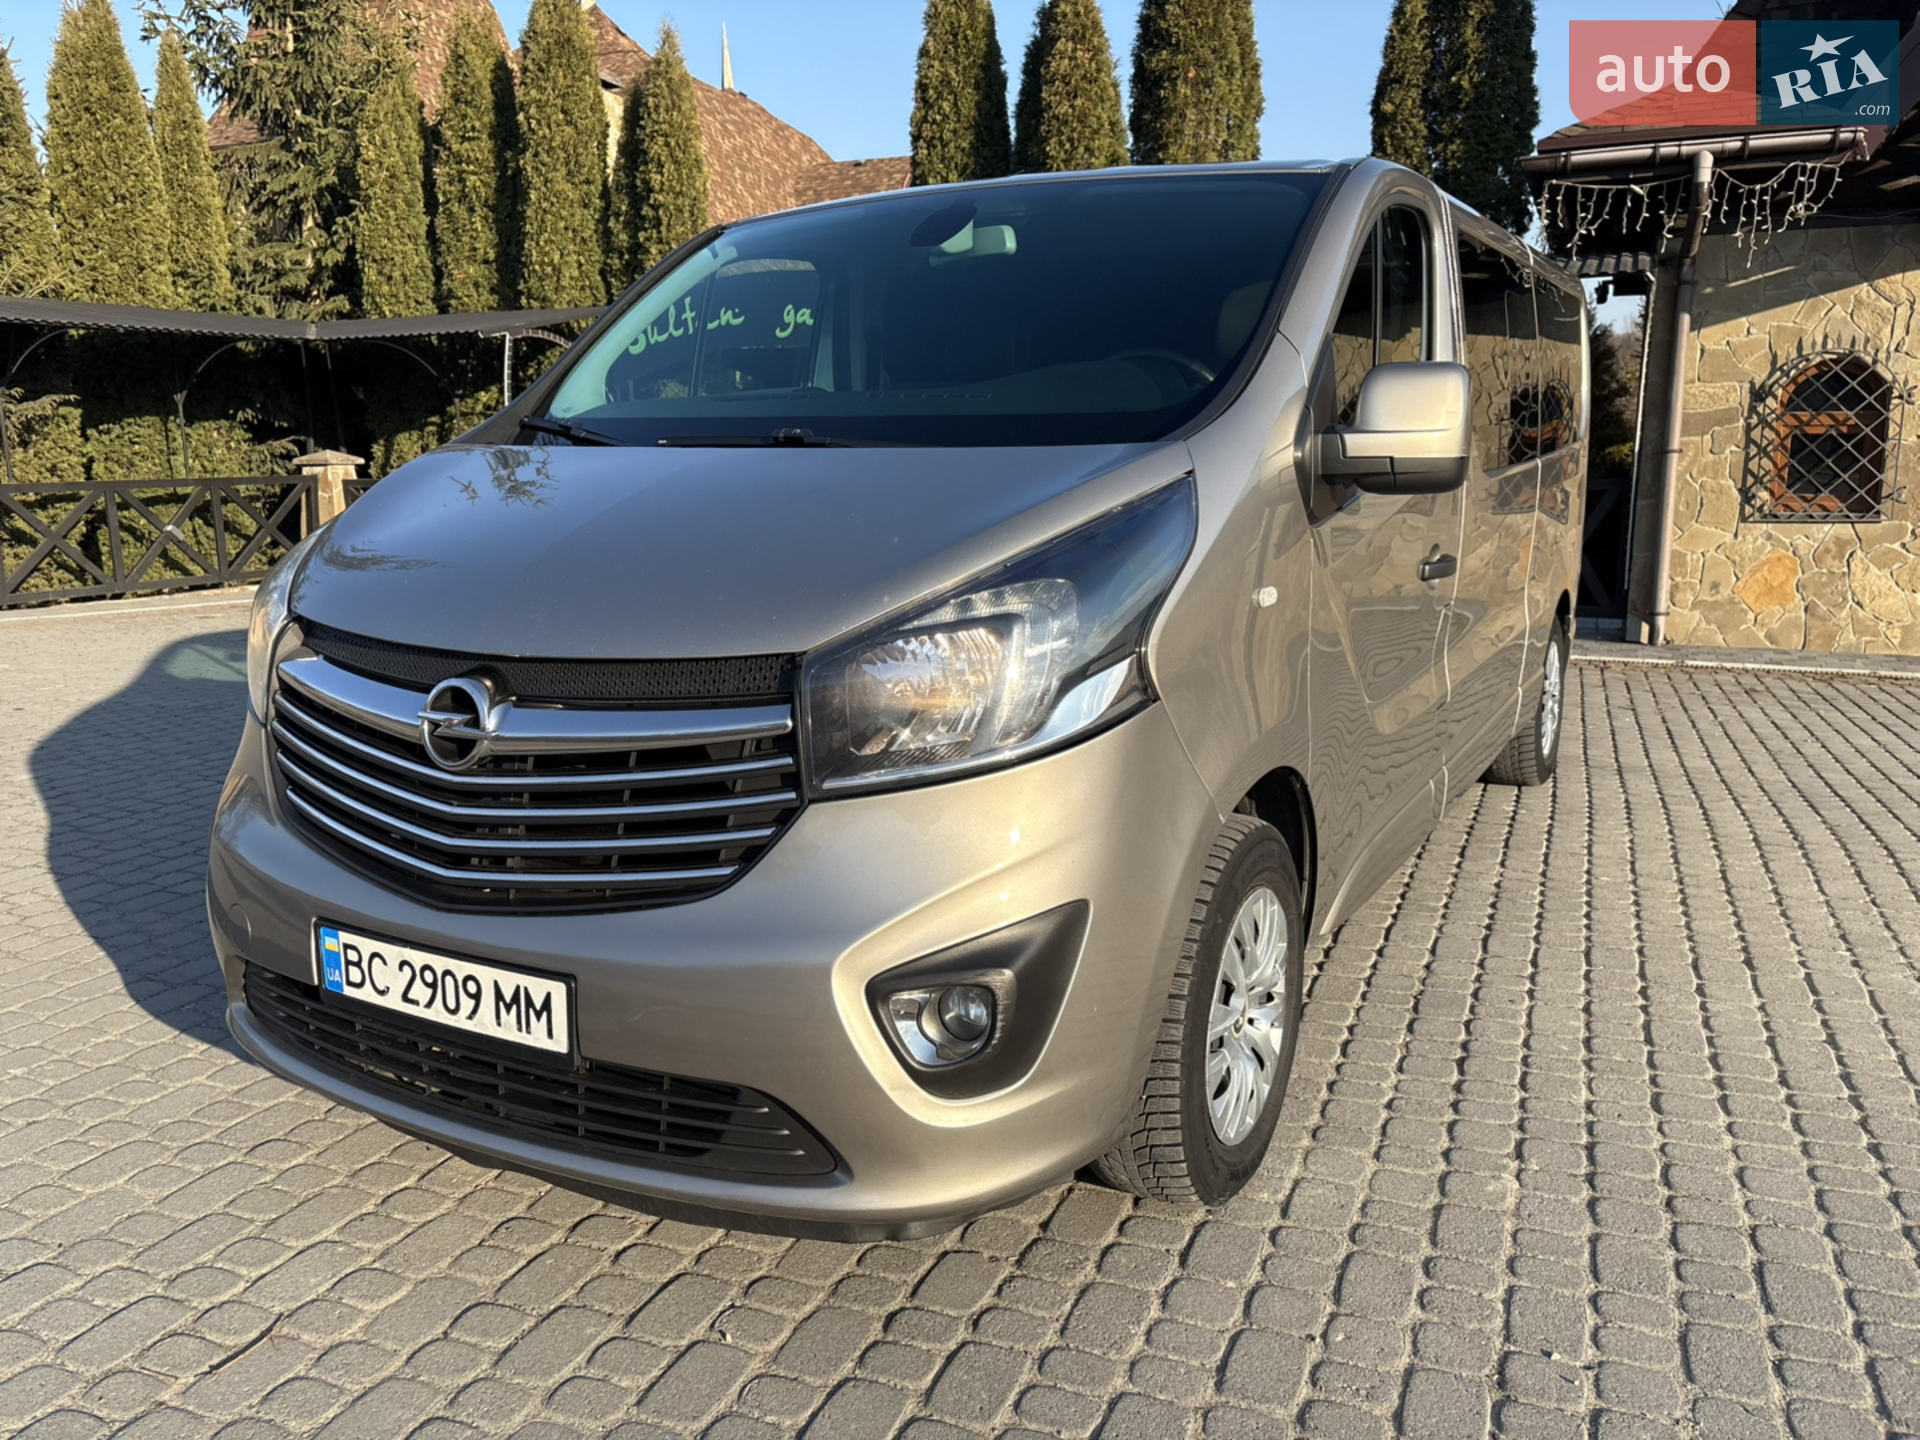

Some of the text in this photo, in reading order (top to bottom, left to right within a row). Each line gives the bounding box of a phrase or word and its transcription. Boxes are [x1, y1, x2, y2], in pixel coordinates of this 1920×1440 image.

[326, 966, 342, 984] UA
[342, 942, 554, 1040] BC 2909 MM
